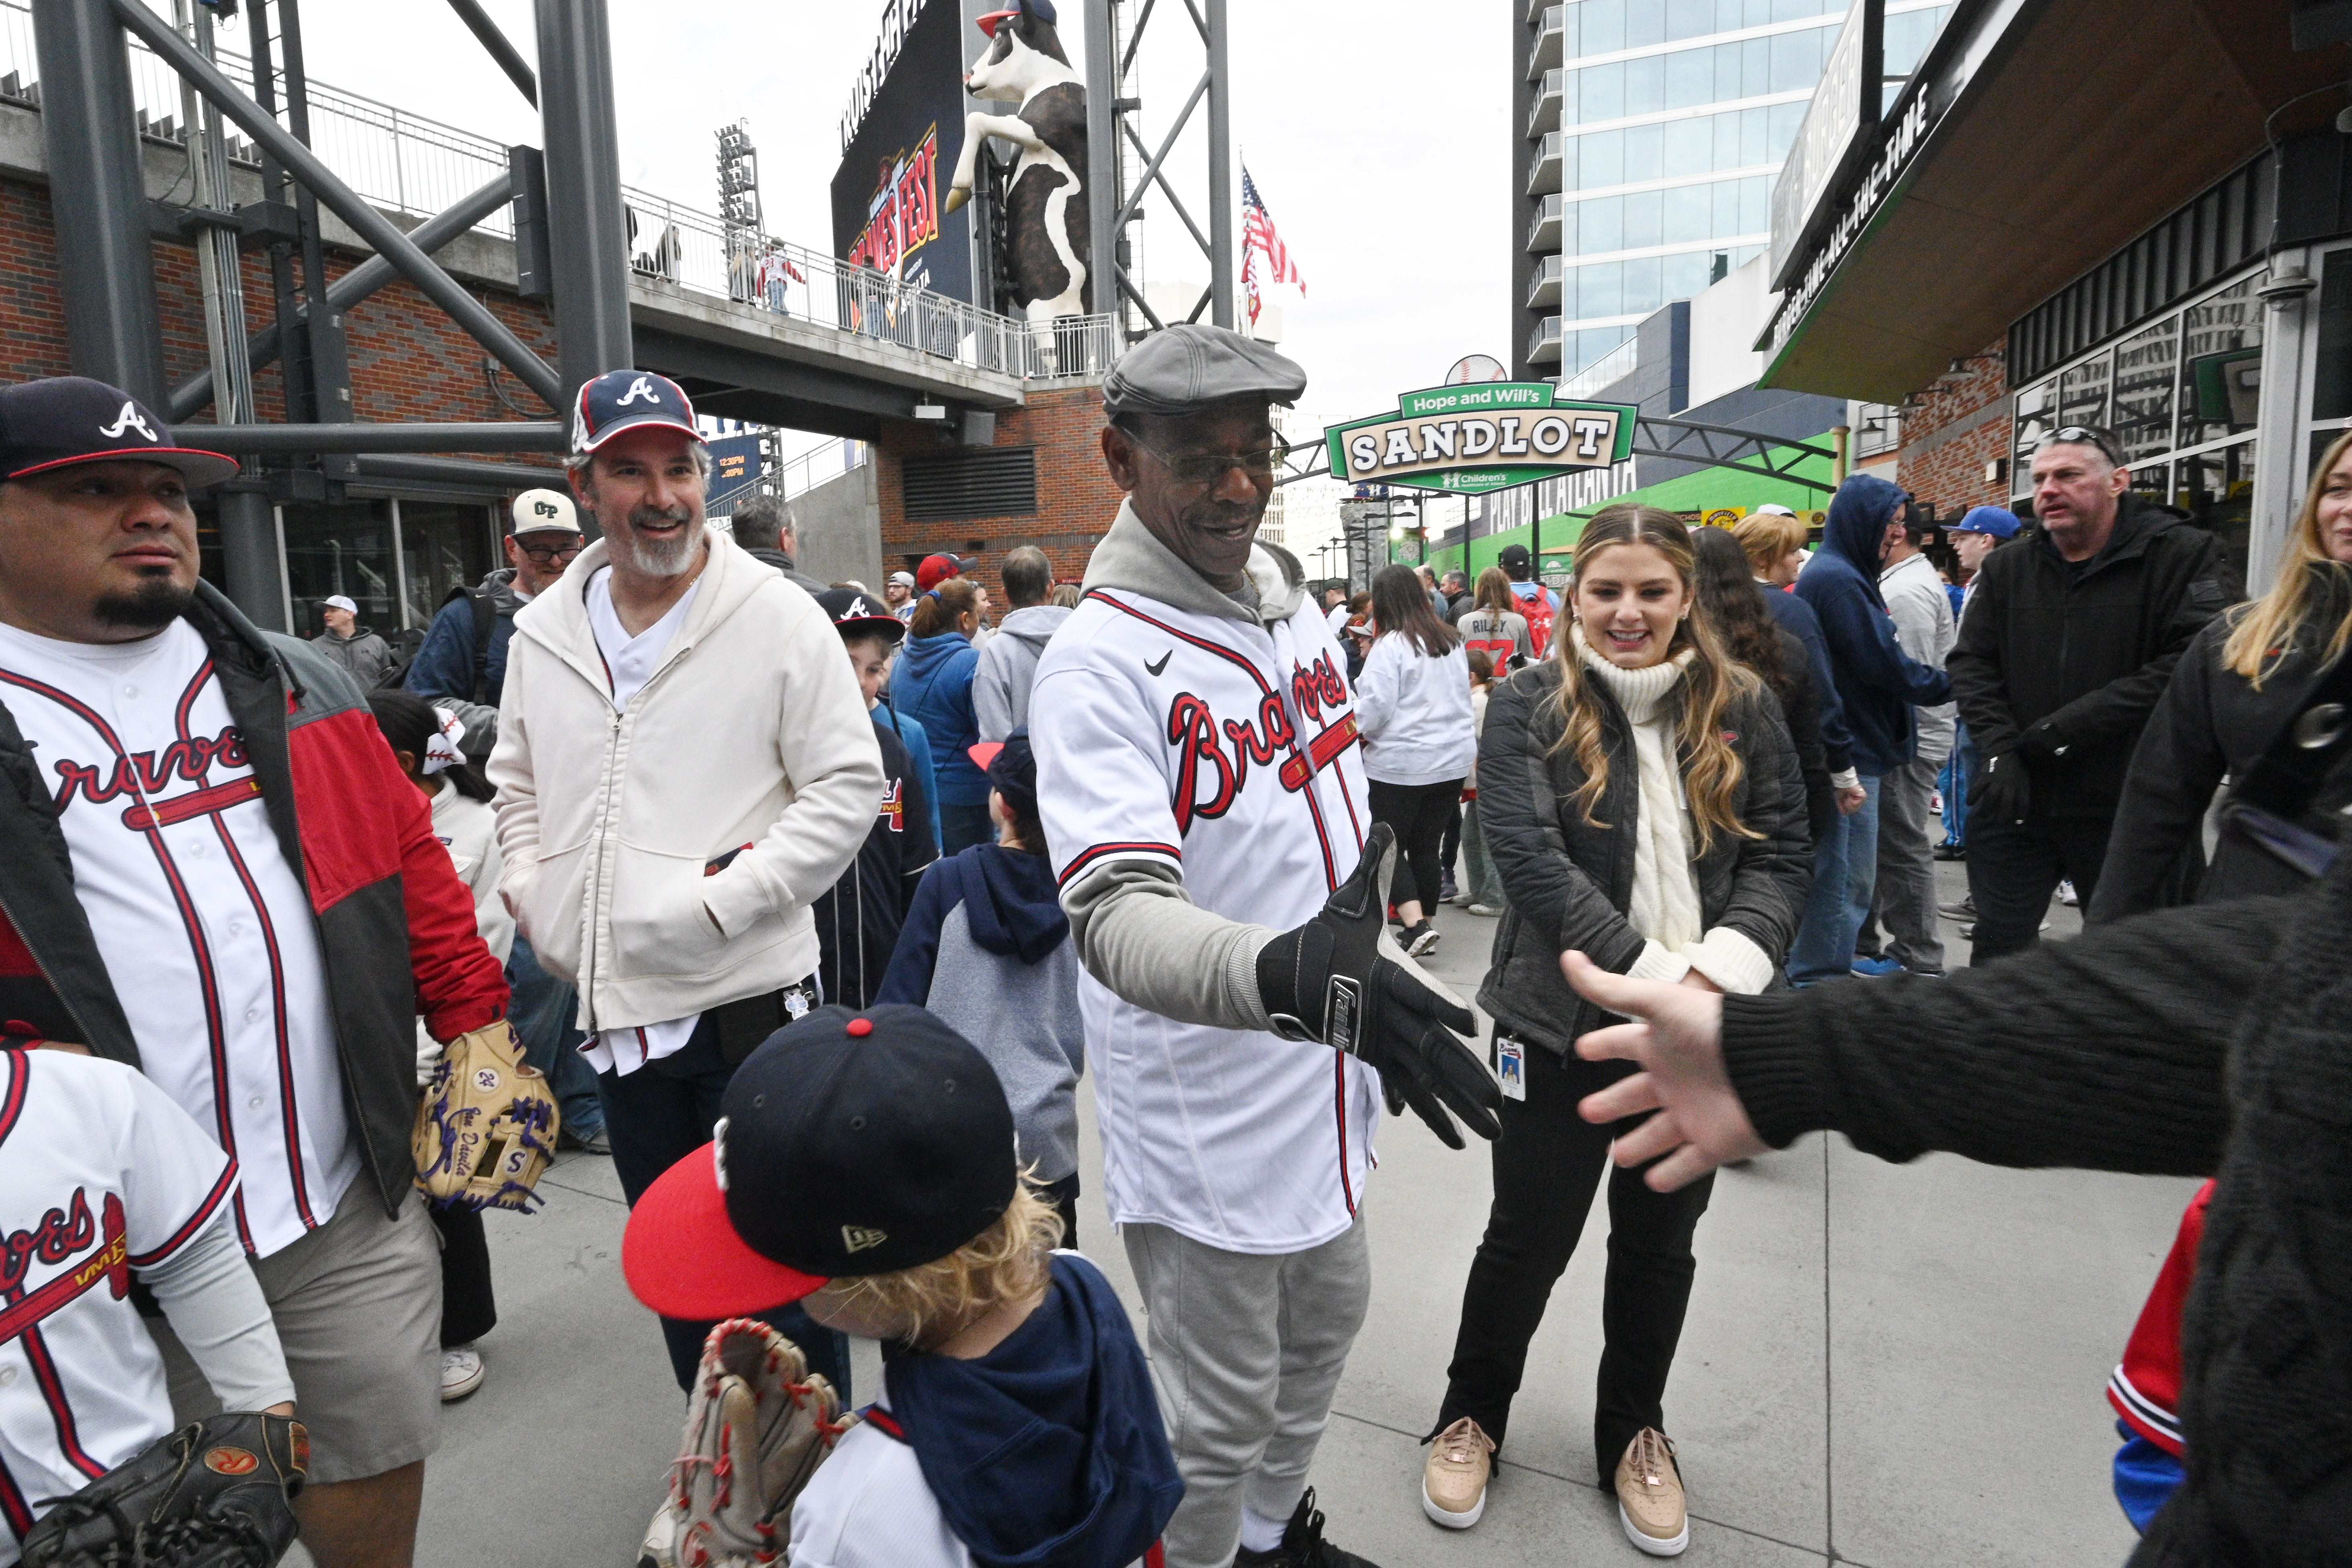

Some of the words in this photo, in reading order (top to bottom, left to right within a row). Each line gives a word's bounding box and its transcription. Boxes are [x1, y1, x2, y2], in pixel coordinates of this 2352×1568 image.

[837, 35, 880, 157] TRUIST
[898, 132, 935, 252] FEST
[616, 376, 660, 406] A
[1414, 391, 1457, 412] Hope
[1459, 390, 1492, 405] and
[1495, 388, 1540, 404] Will's
[99, 401, 158, 442] A
[1351, 416, 1610, 473] SANDLOT
[1461, 473, 1506, 483] Children's
[1490, 487, 1516, 535] PLAY
[840, 596, 871, 620] A
[1465, 639, 1515, 677] 7
[1167, 647, 1347, 840] Braves
[52, 726, 252, 816] rave
